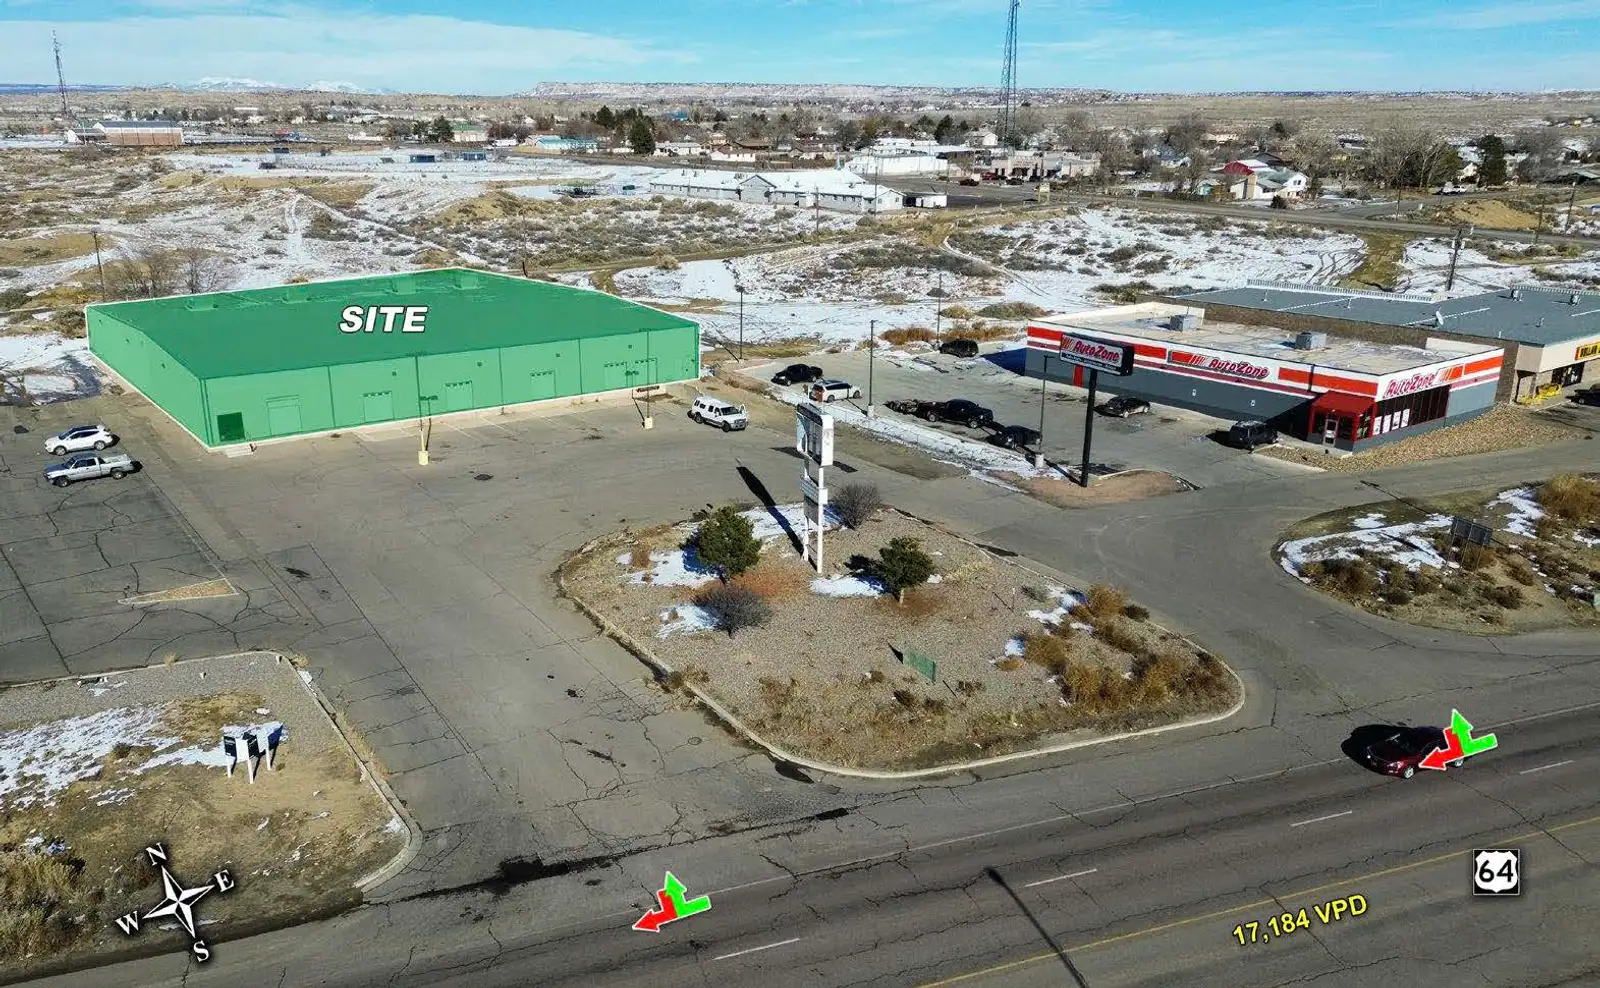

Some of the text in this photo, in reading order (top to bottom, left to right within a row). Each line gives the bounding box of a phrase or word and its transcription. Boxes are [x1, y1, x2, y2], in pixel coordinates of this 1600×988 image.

[1074, 340, 1120, 363] AutoZone
[1208, 357, 1269, 378] AutoZone
[1385, 374, 1436, 397] AutoZone
